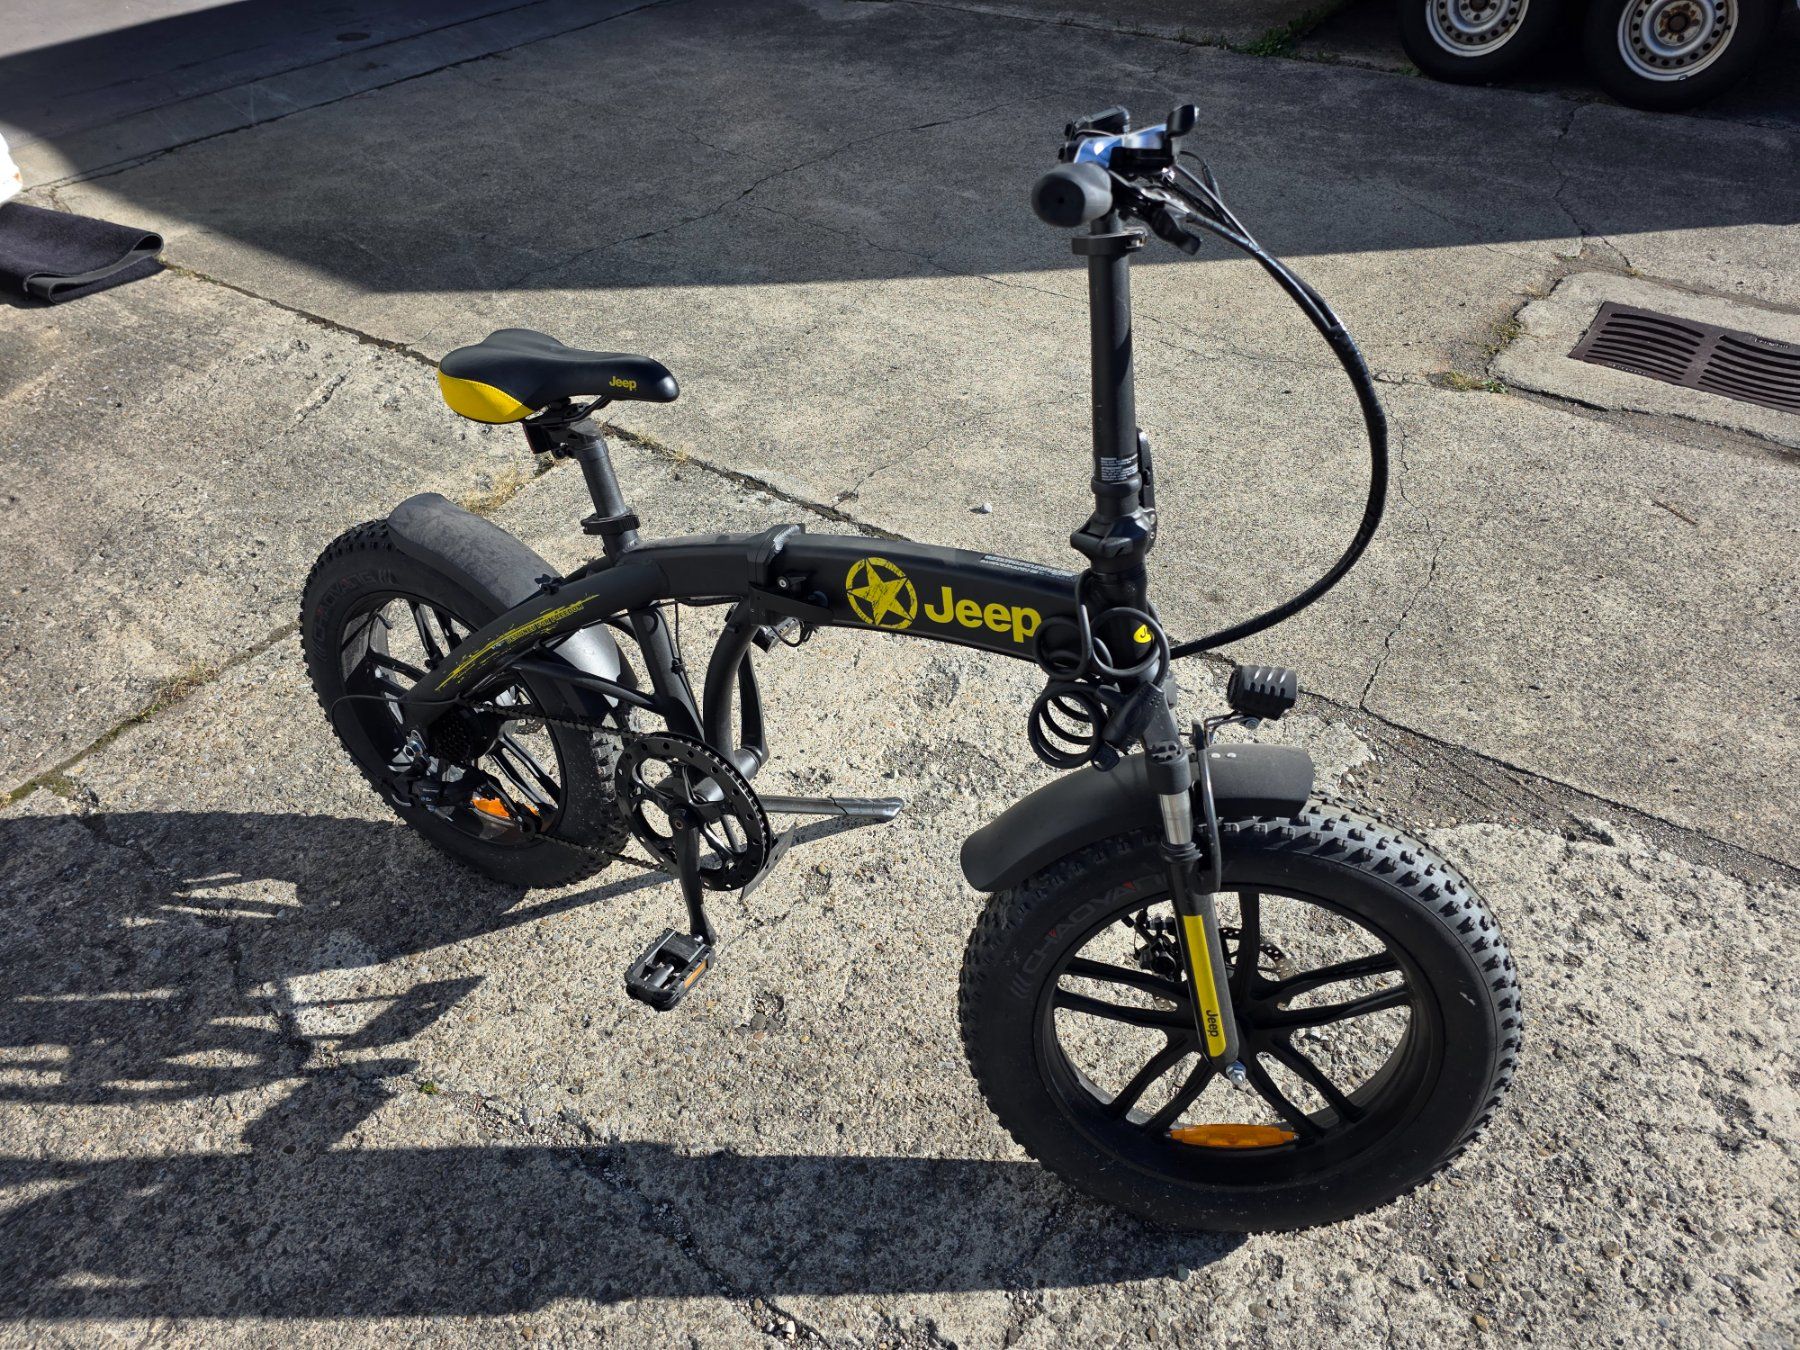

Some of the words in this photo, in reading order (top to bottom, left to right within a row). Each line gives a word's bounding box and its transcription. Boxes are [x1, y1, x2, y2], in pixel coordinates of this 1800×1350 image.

[608, 375, 637, 391] Jeep
[924, 586, 1042, 643] Jeep
[1205, 1009, 1219, 1038] Jeep
